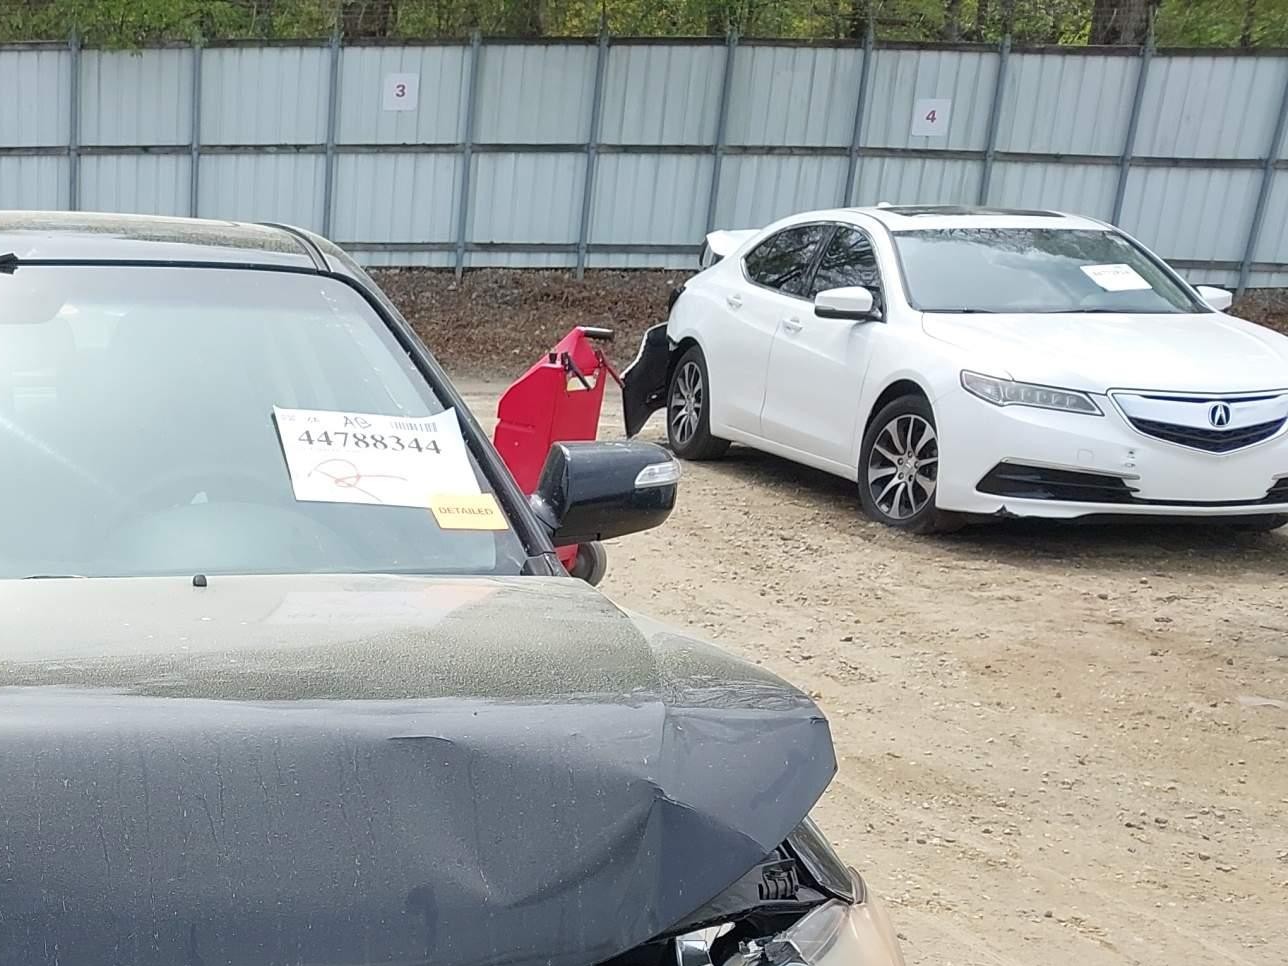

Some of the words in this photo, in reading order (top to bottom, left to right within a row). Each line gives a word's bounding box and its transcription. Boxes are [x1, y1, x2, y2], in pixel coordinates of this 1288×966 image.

[395, 84, 406, 98] 3
[925, 110, 937, 123] 4
[298, 430, 442, 454] 44788344
[438, 506, 494, 516] DETAILED
